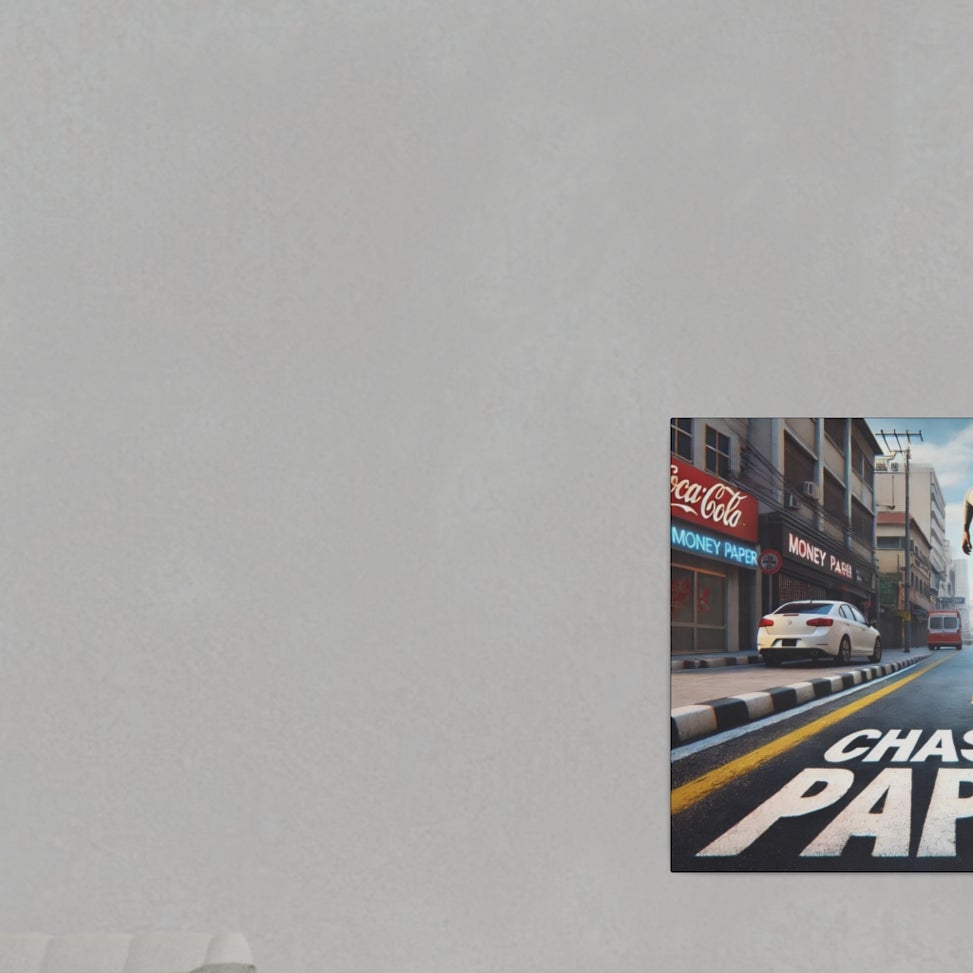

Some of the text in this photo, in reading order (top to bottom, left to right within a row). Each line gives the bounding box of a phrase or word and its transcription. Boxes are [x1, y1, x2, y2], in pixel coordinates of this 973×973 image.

[671, 526, 758, 566] MONEY PAPER
[788, 532, 827, 567] MONEY
